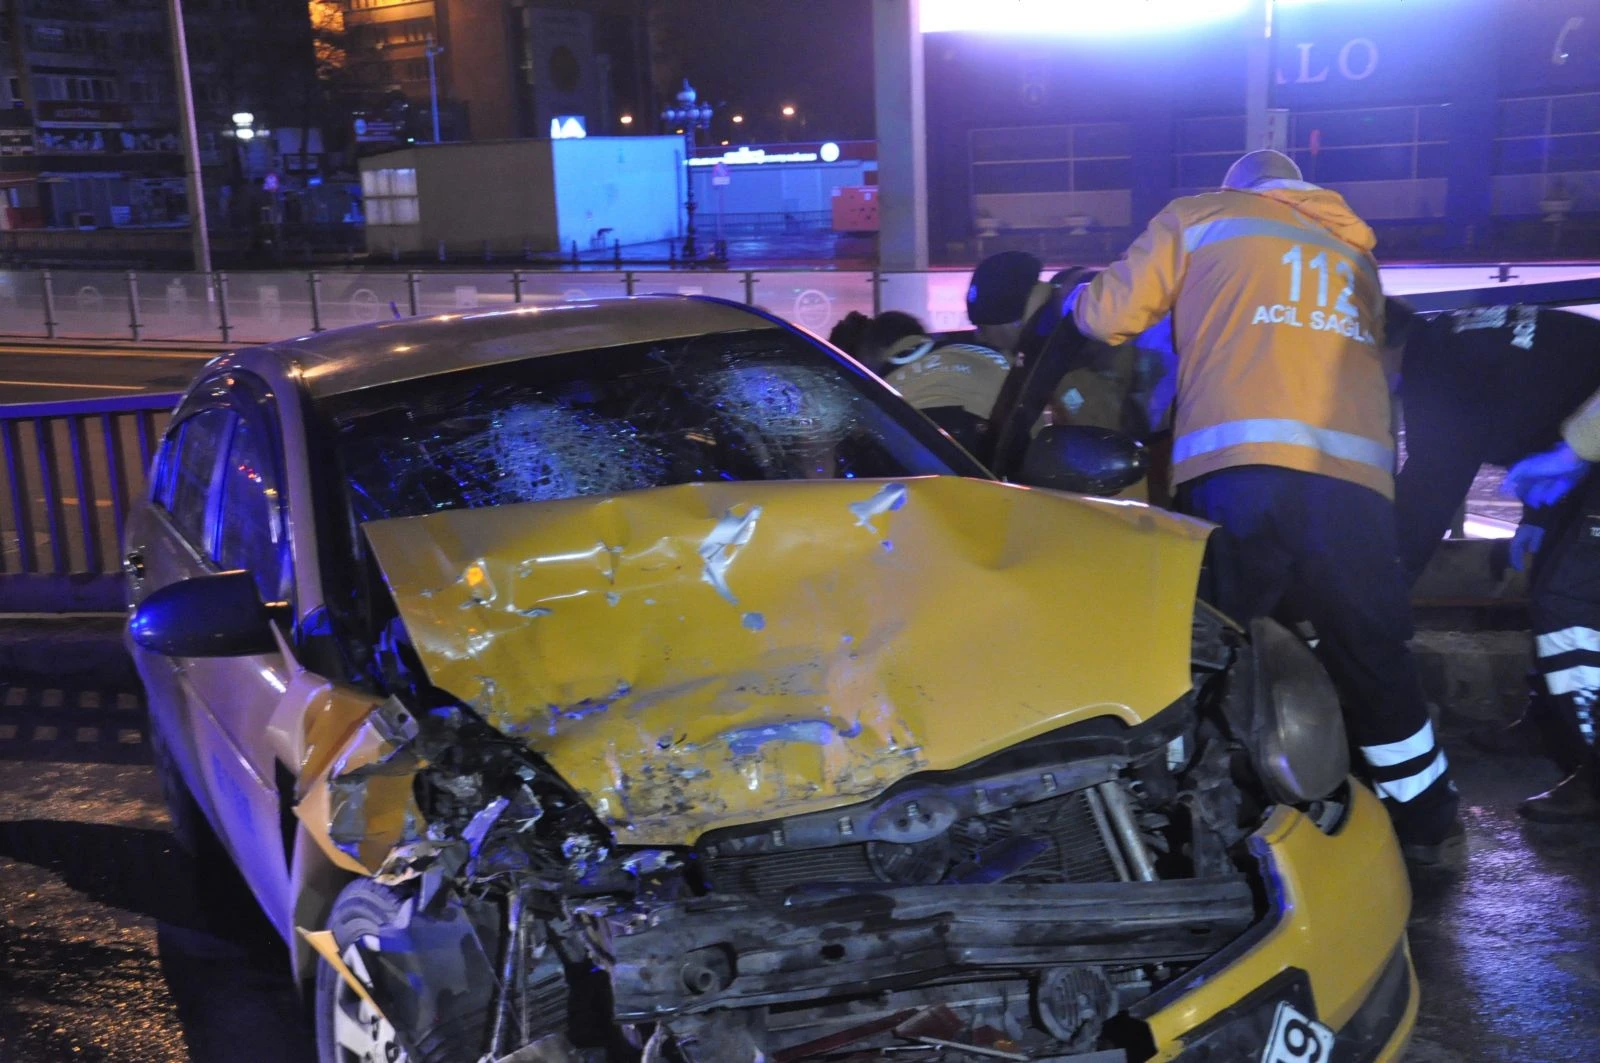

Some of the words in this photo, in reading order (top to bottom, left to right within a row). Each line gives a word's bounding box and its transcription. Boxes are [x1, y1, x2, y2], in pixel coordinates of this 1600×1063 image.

[1276, 37, 1377, 84] LO
[1281, 244, 1359, 317] 112
[1277, 1019, 1322, 1063] 9
